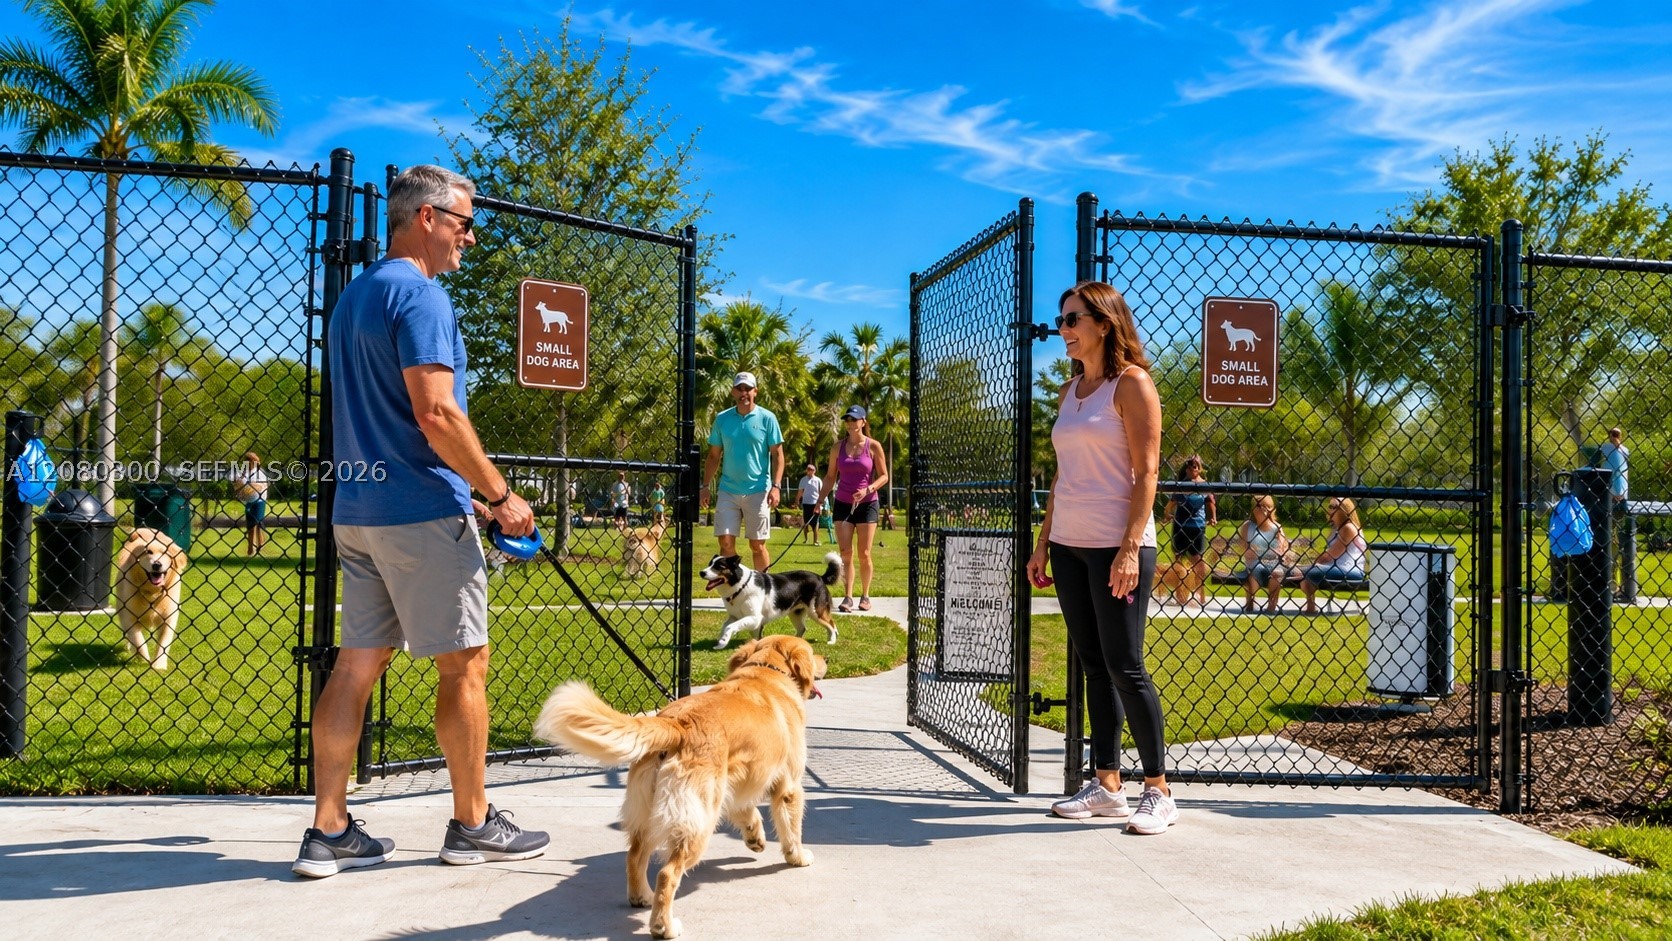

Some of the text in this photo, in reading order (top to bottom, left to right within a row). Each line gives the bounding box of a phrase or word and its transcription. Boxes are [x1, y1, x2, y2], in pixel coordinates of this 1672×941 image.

[536, 341, 572, 355] SMALL
[526, 355, 579, 370] DOG AREA
[1221, 360, 1260, 372] SMALL
[1211, 374, 1268, 386] DOG AREA
